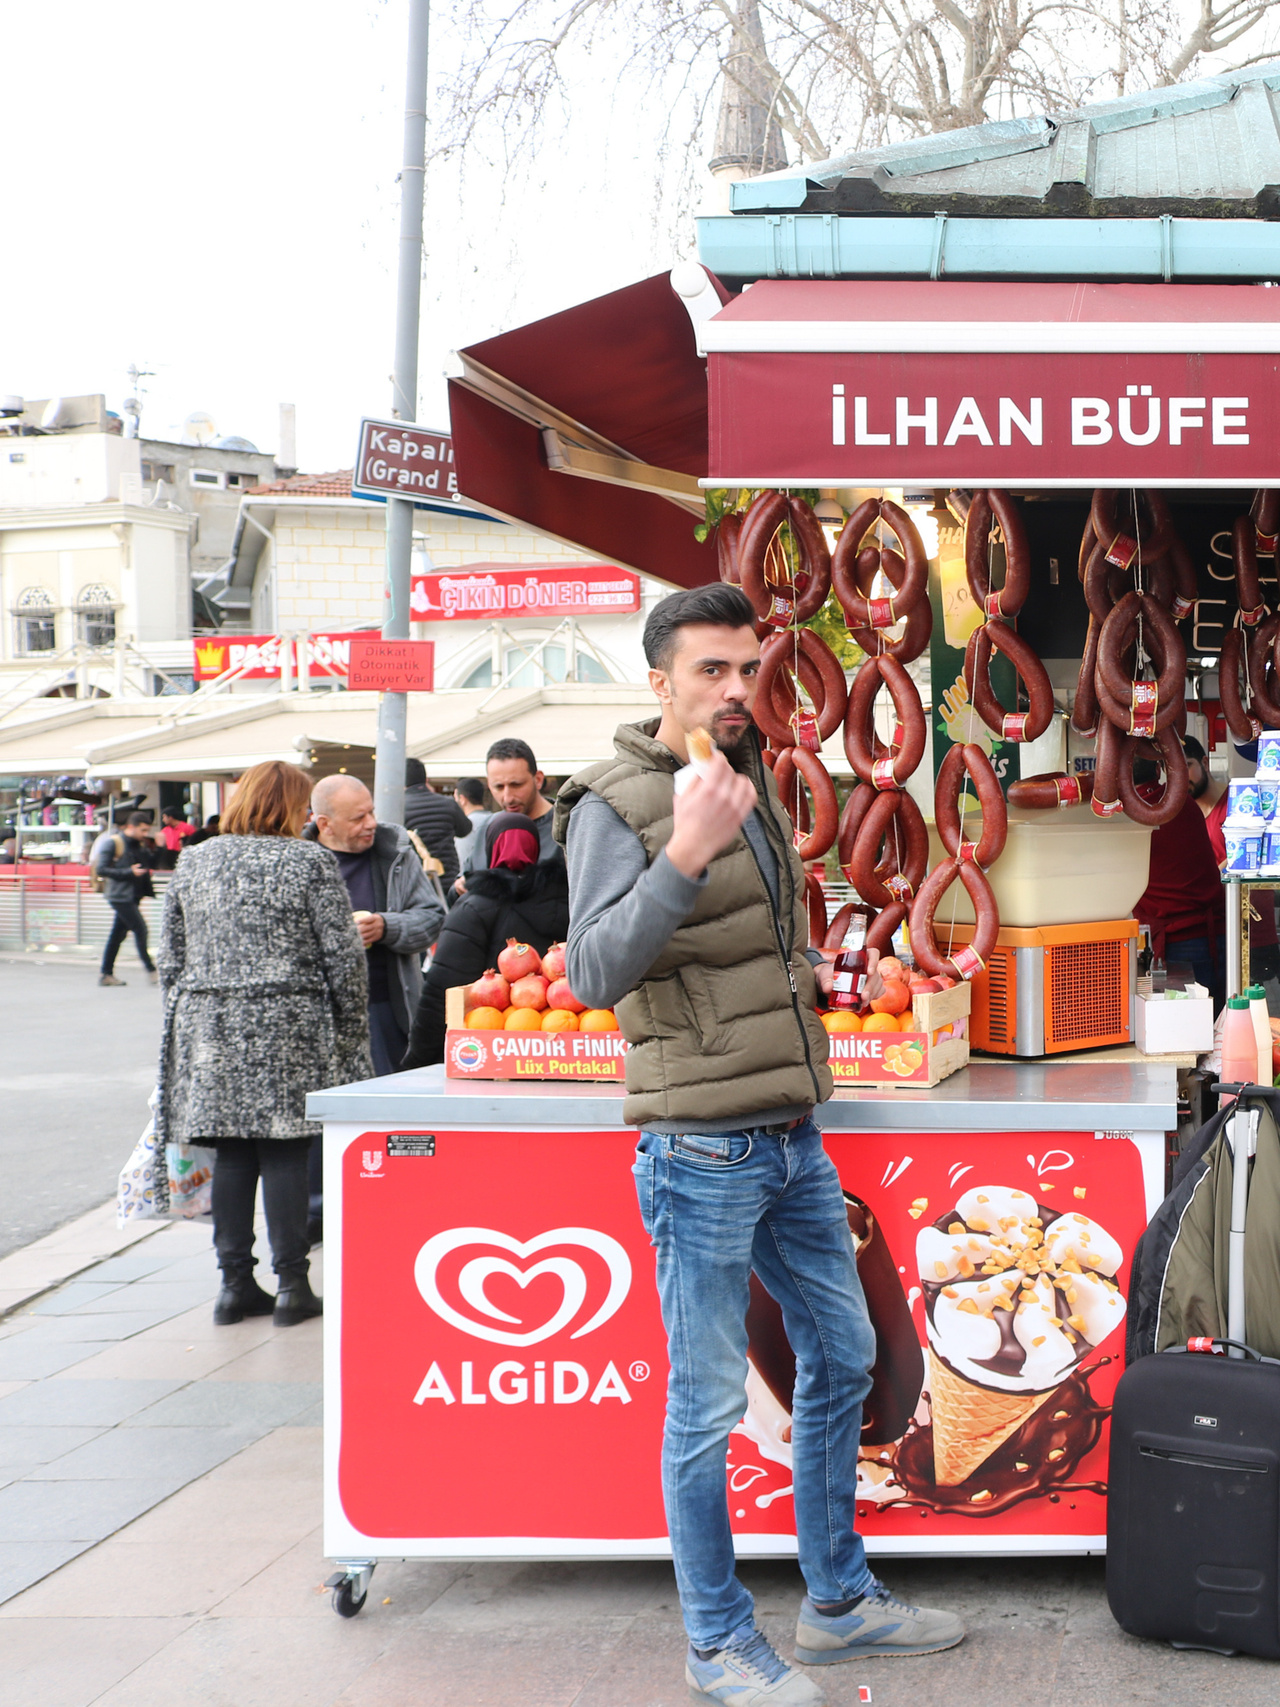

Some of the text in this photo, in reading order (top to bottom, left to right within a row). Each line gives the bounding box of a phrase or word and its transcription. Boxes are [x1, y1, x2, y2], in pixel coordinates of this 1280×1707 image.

[832, 384, 1250, 446] İLHAN BÜFE
[366, 456, 439, 489] (Grand
[507, 578, 587, 608] DÖNER
[366, 647, 406, 657] Dikkat
[360, 660, 419, 670] Otomatik
[353, 673, 425, 685] Bariyer Var
[1075, 757, 1096, 772] SET
[828, 1036, 883, 1060] İNİKE
[516, 1059, 617, 1075] Lüx Portakal
[828, 1061, 860, 1077] akal
